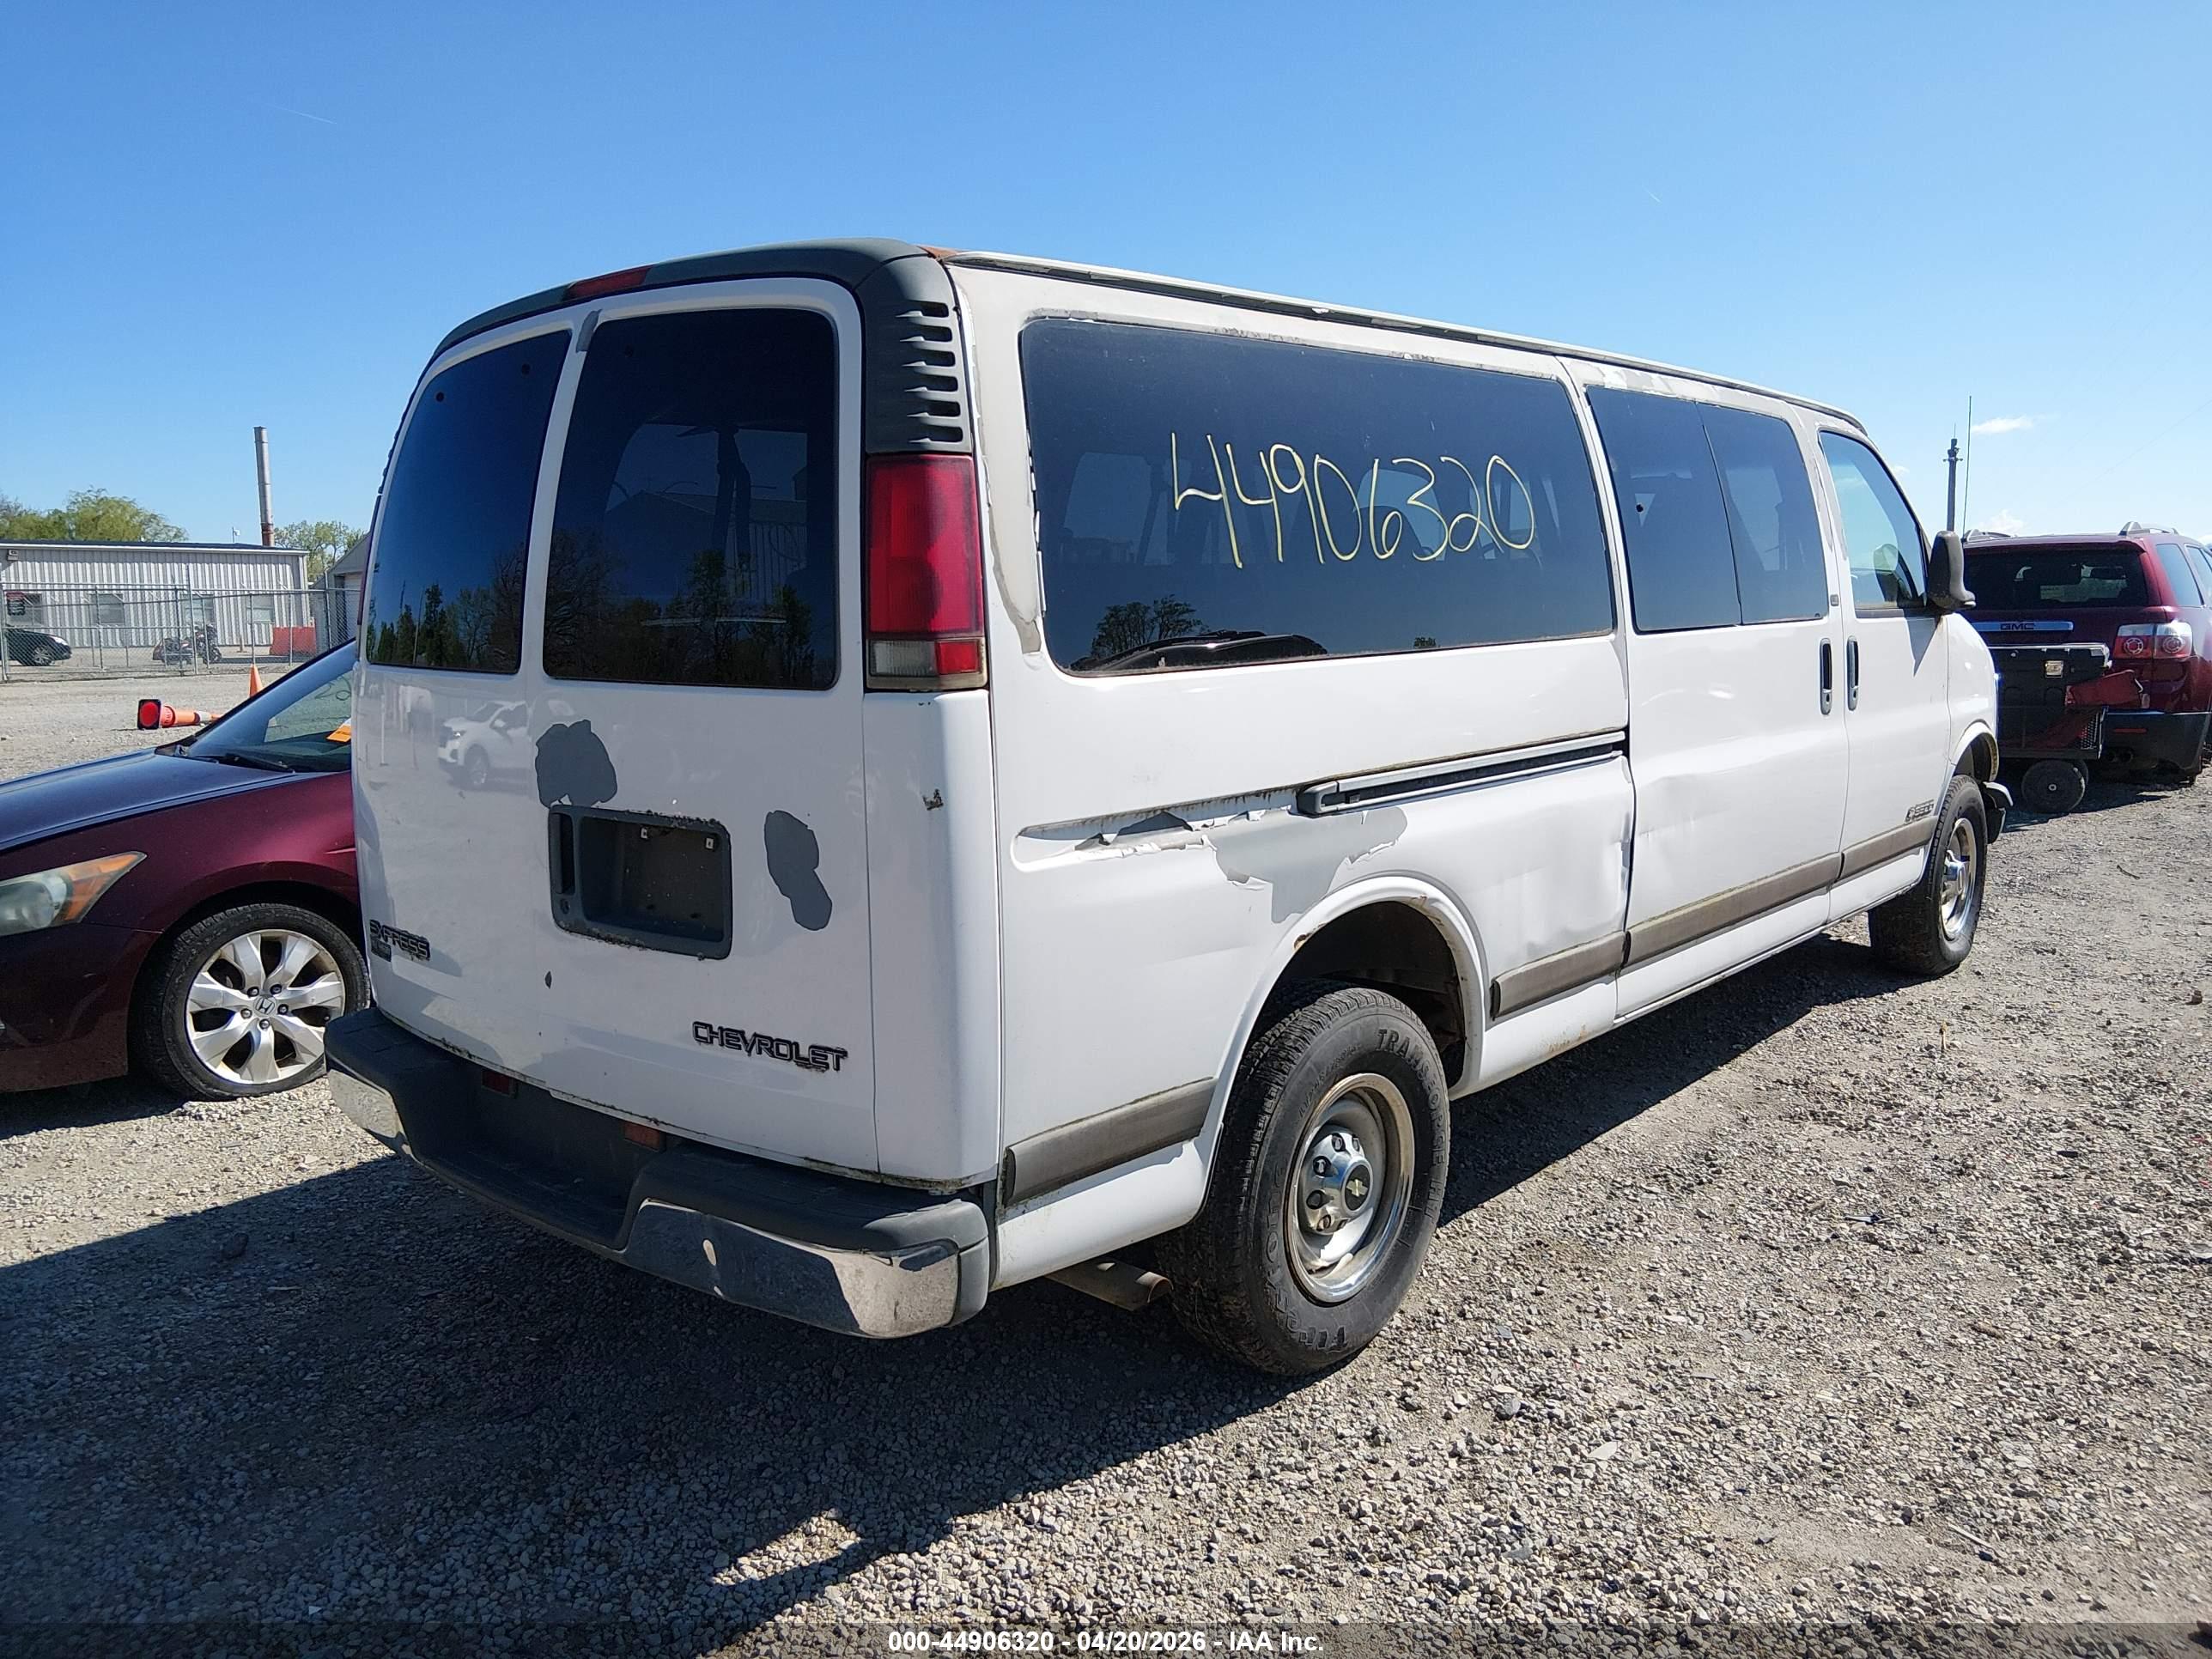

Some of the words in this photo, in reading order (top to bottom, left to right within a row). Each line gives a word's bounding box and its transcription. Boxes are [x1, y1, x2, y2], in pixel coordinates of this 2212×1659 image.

[1170, 431, 1535, 569] 44906320
[2000, 622, 2035, 630] GMC
[369, 919, 431, 961] EXPRESS
[692, 1020, 848, 1073] CHEVROLET
